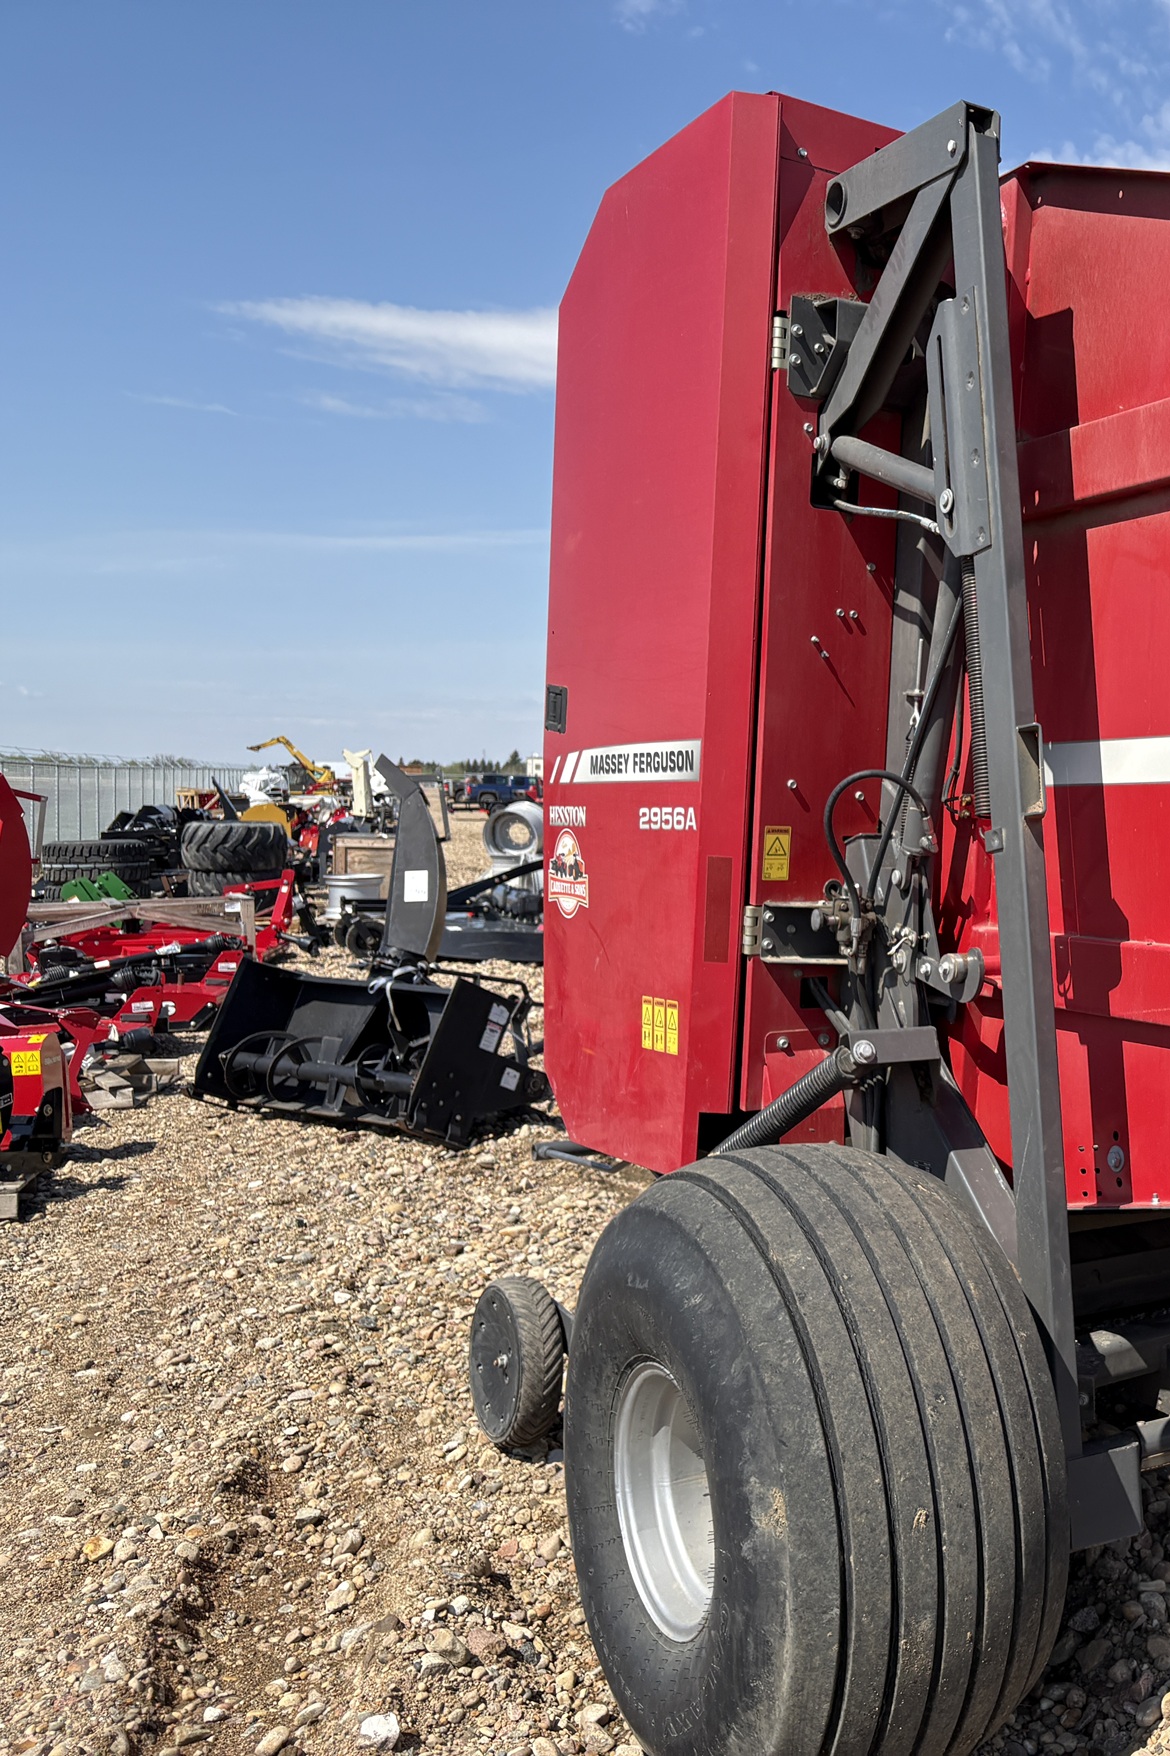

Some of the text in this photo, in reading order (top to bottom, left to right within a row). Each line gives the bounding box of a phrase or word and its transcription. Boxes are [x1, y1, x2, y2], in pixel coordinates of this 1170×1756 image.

[590, 749, 694, 776] MASSEY FERGUSON
[549, 805, 587, 827] HESSTON
[639, 806, 698, 831] 2956A
